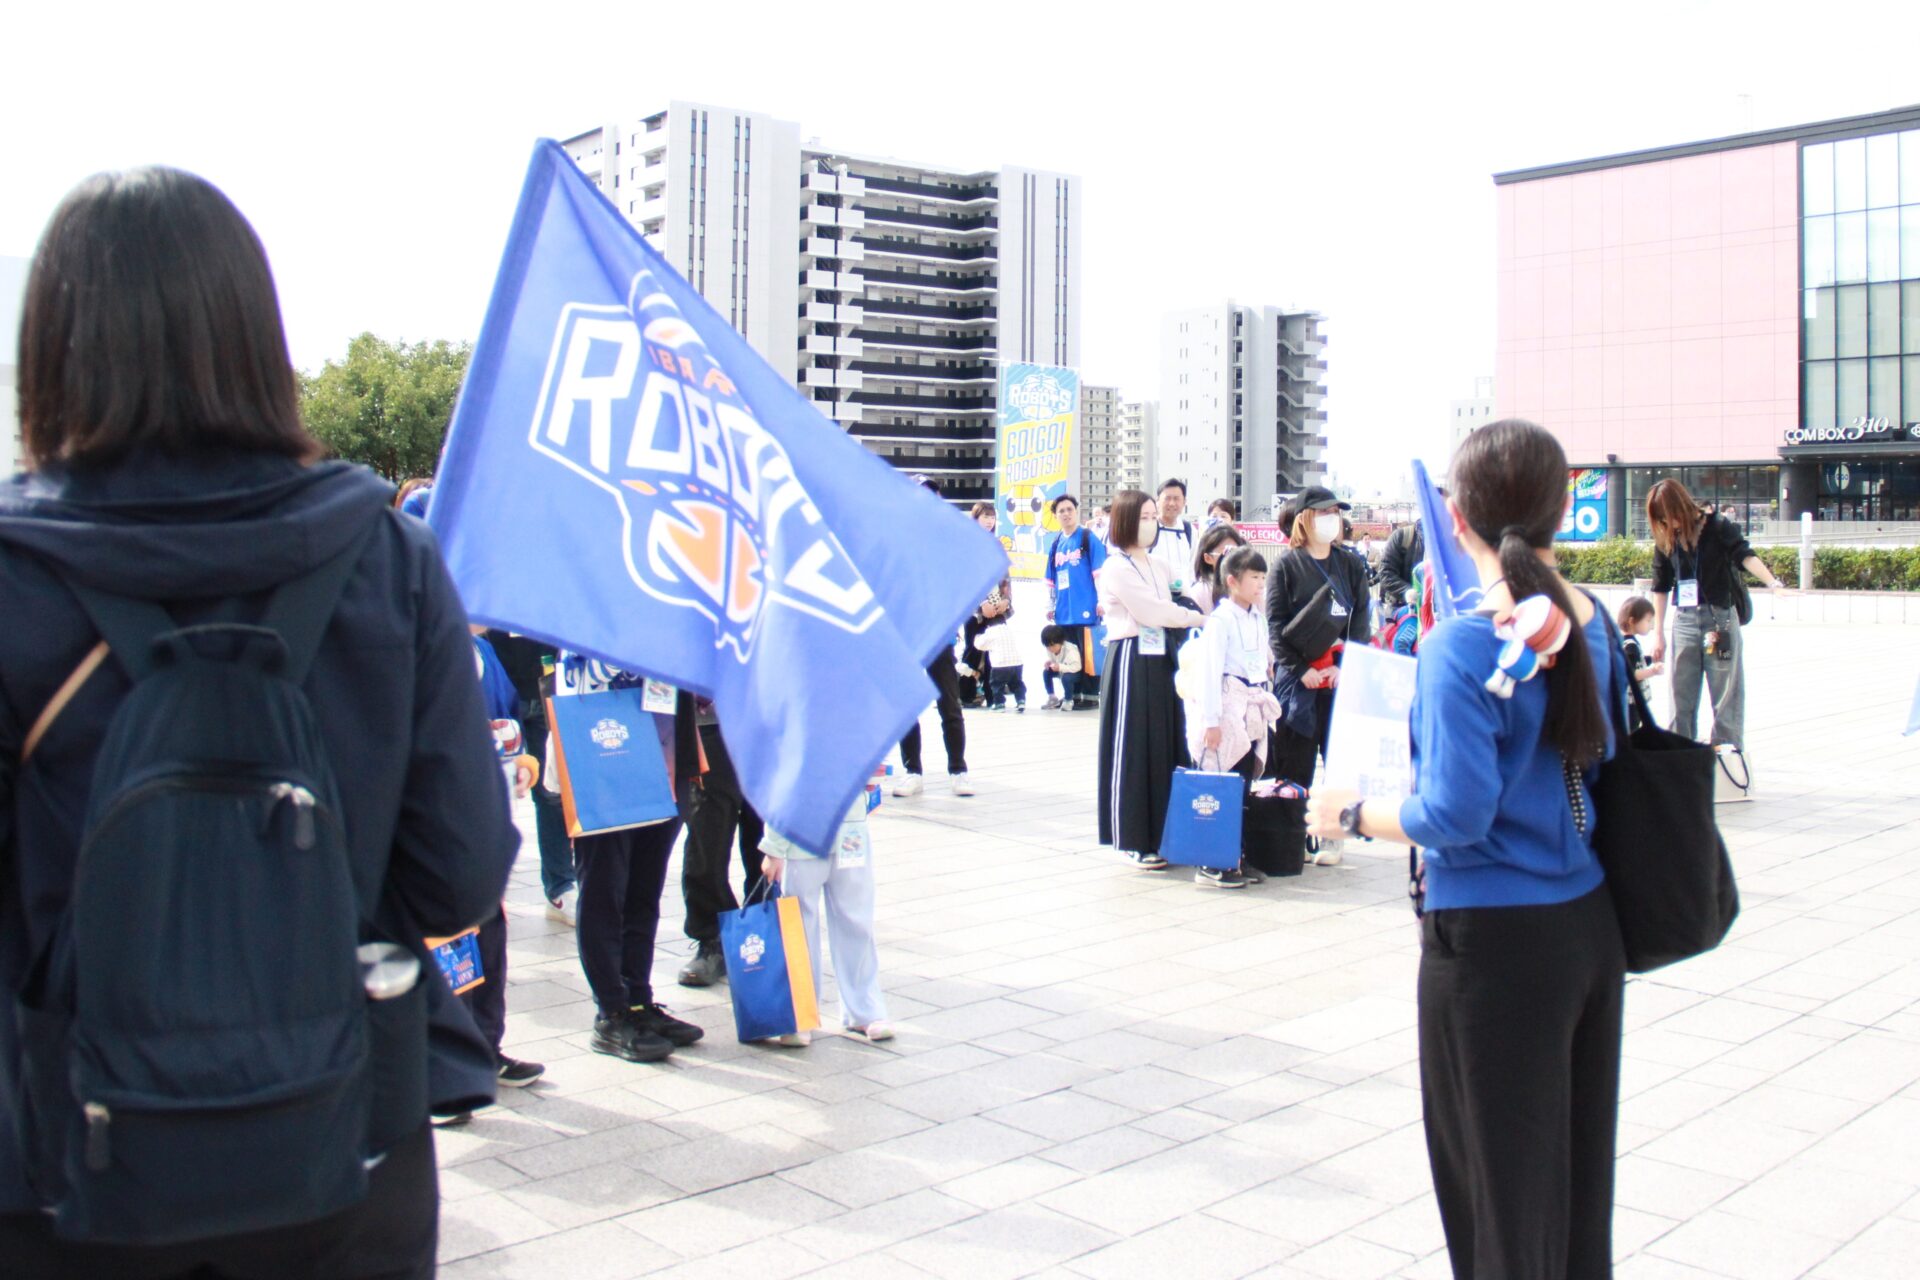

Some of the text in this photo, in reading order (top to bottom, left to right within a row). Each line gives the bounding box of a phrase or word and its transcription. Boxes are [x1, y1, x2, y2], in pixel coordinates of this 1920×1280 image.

[1008, 383, 1072, 412] ROBOTS
[1239, 529, 1284, 542] BIG ECHO
